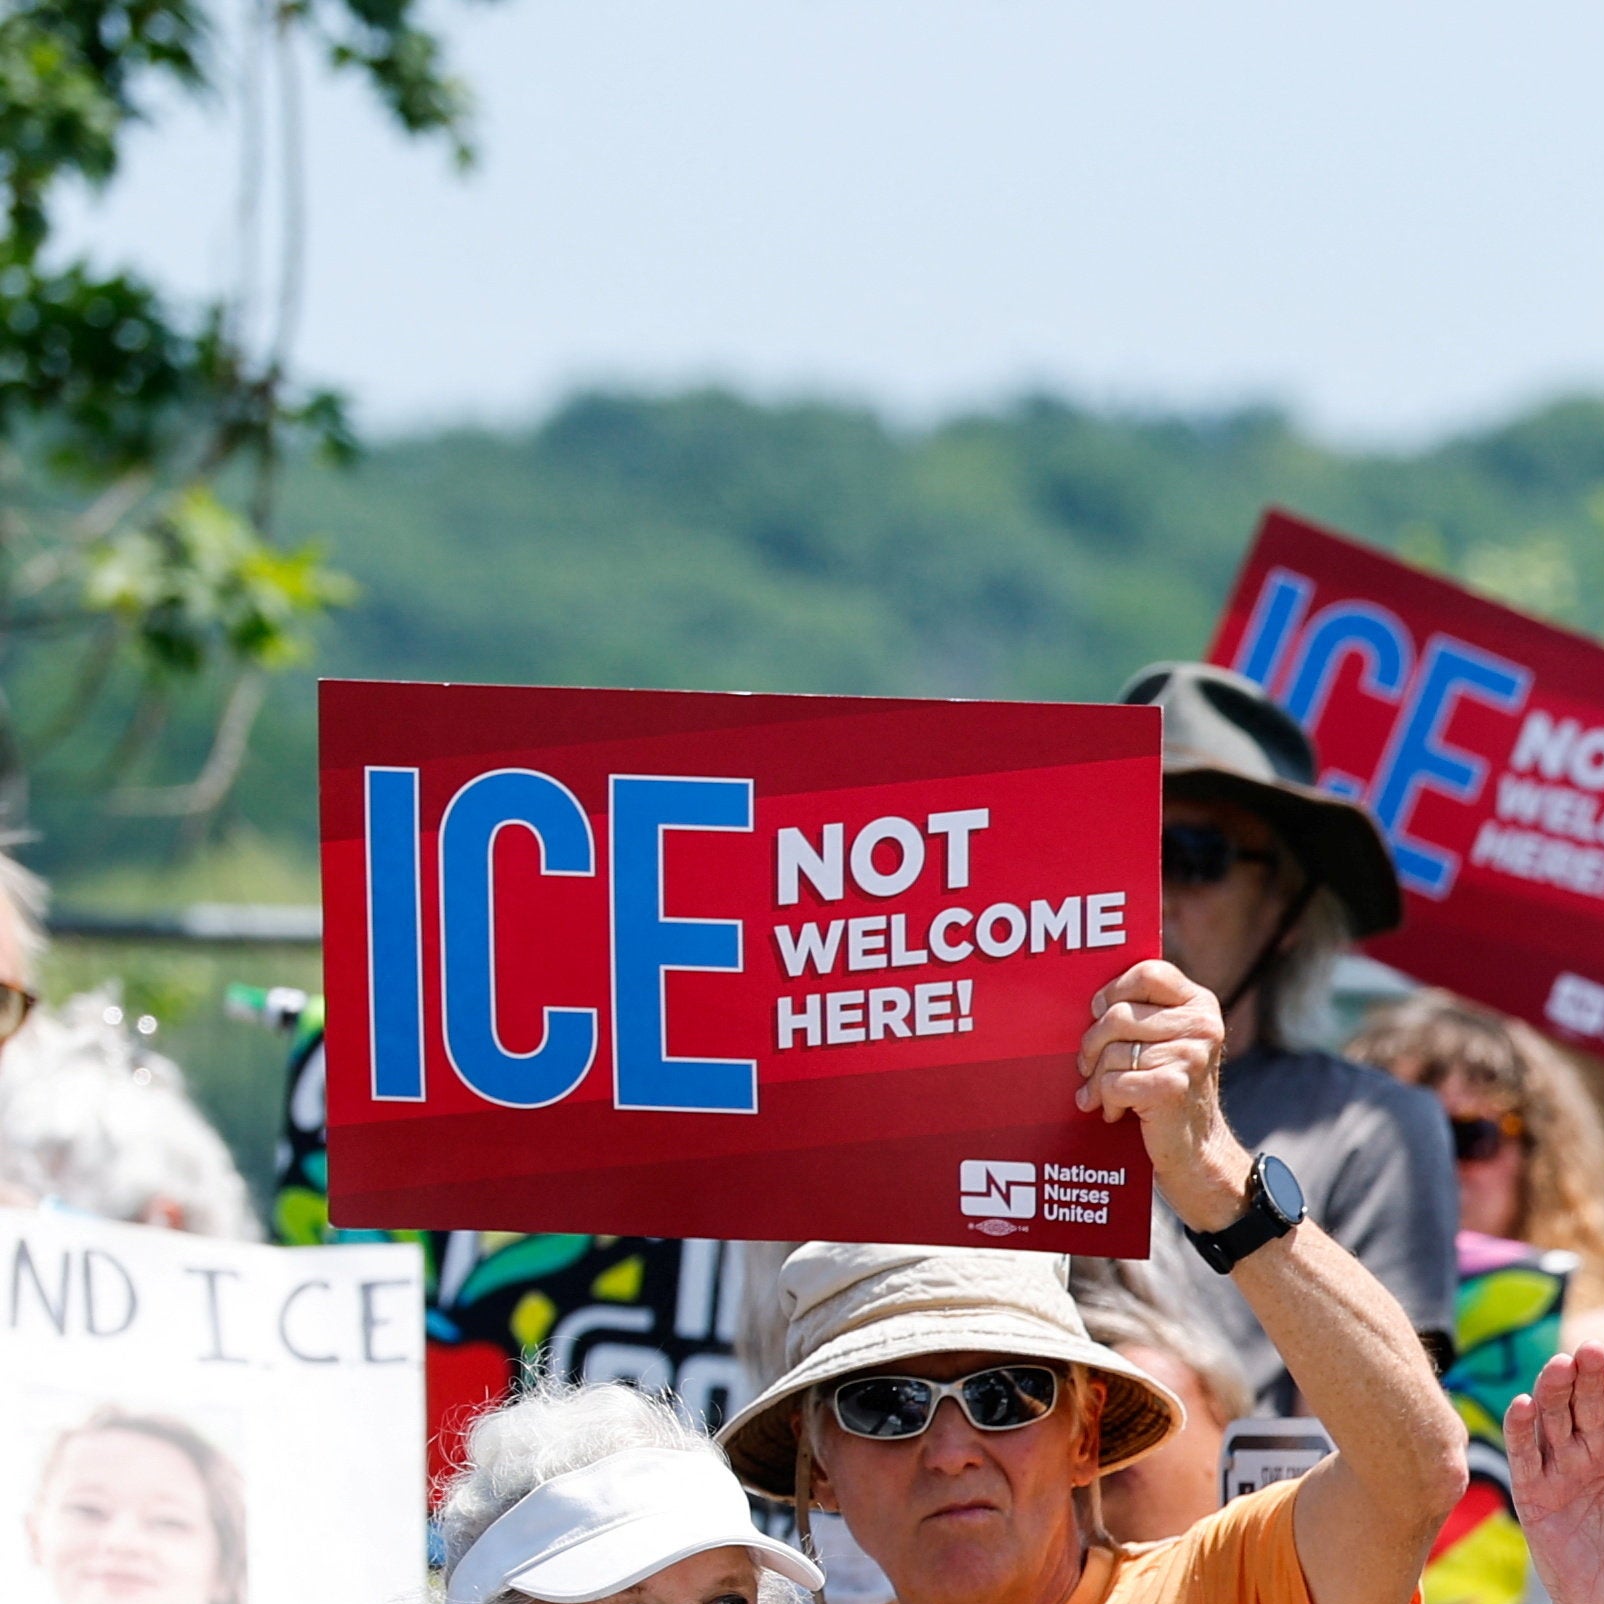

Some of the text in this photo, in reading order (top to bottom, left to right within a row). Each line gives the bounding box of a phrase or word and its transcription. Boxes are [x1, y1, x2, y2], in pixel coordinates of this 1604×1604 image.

[777, 808, 989, 905] NOT
[364, 766, 758, 1114] ICE
[774, 891, 1126, 977] WELCOME
[777, 979, 973, 1049] HERE!
[1043, 1163, 1126, 1185] National
[1043, 1183, 1110, 1204] Nurses
[1043, 1203, 1108, 1224] United
